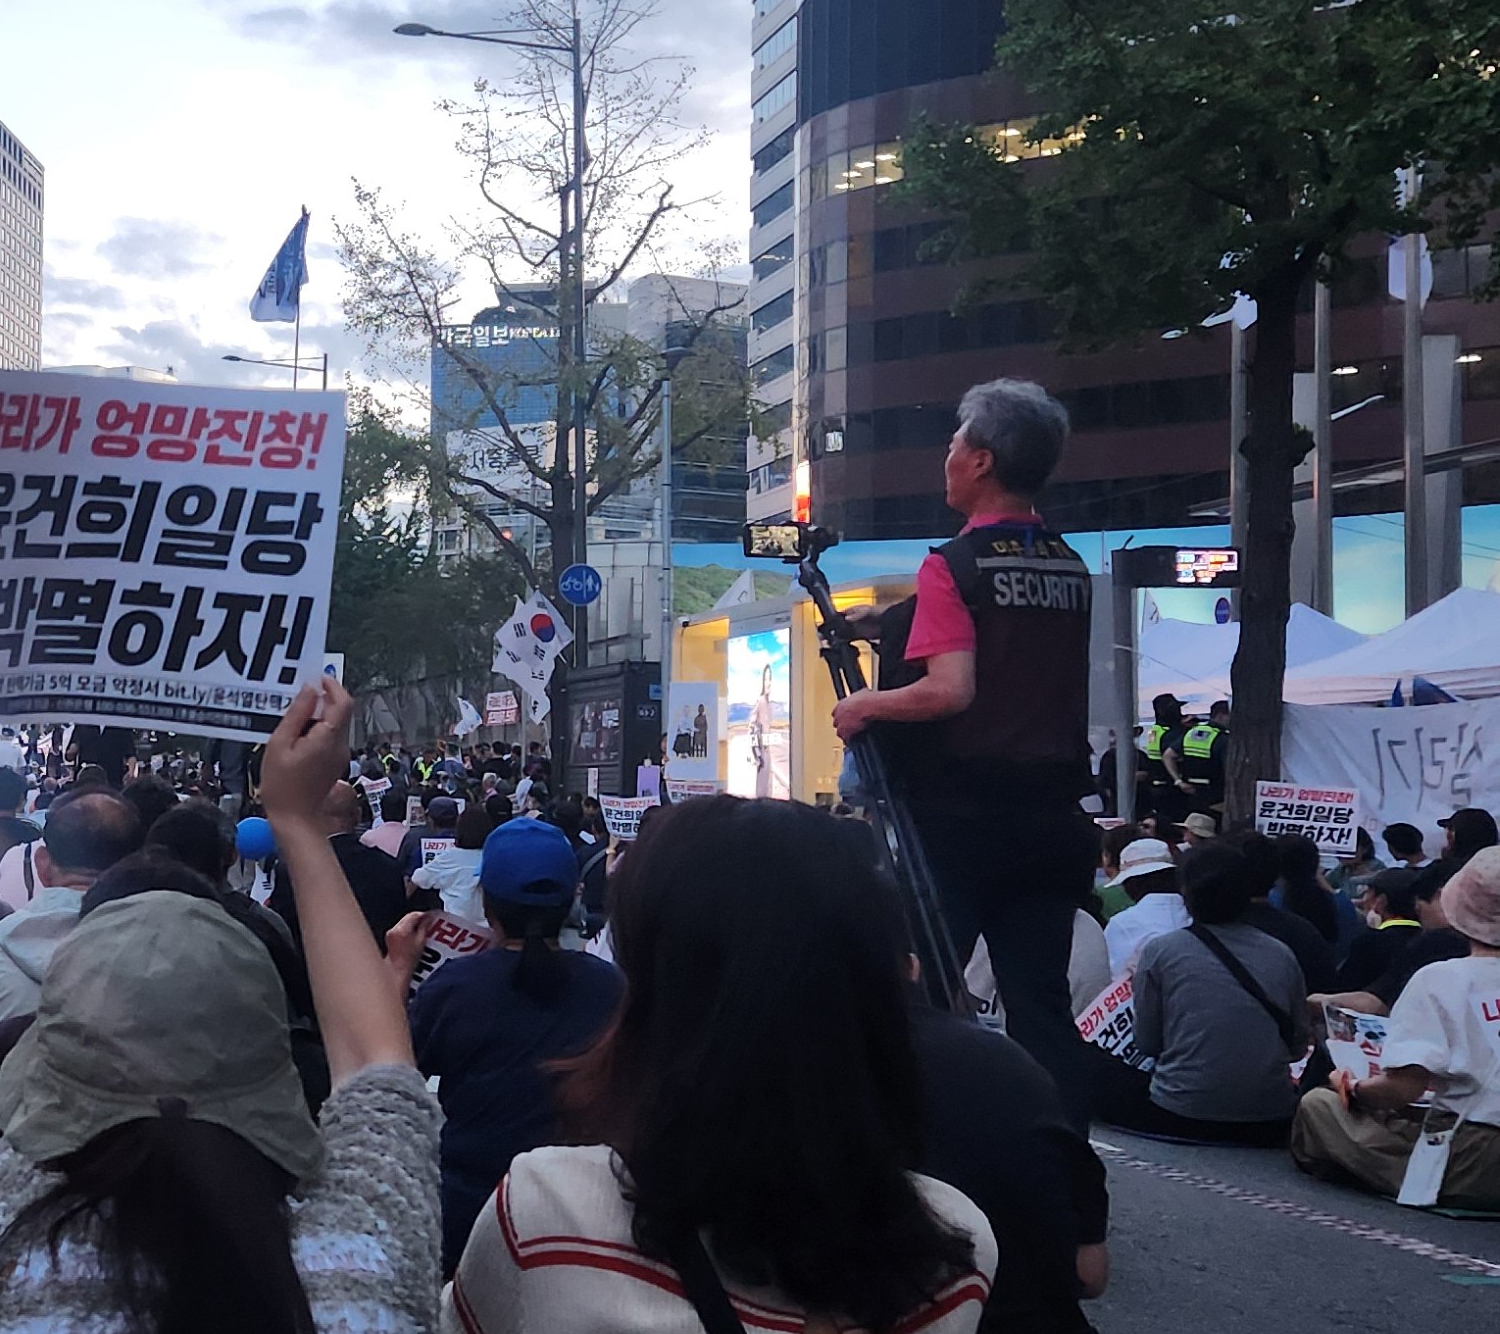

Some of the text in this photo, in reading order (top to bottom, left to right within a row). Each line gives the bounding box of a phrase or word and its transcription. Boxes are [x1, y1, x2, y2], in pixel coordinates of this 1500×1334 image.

[91, 399, 329, 471] 엉망진창!
[993, 571, 1090, 611] SECURITY
[50, 673, 72, 692] 5억
[76, 675, 107, 694] 모금
[112, 677, 160, 697] 약정서
[1259, 800, 1355, 824] 윤건희일당
